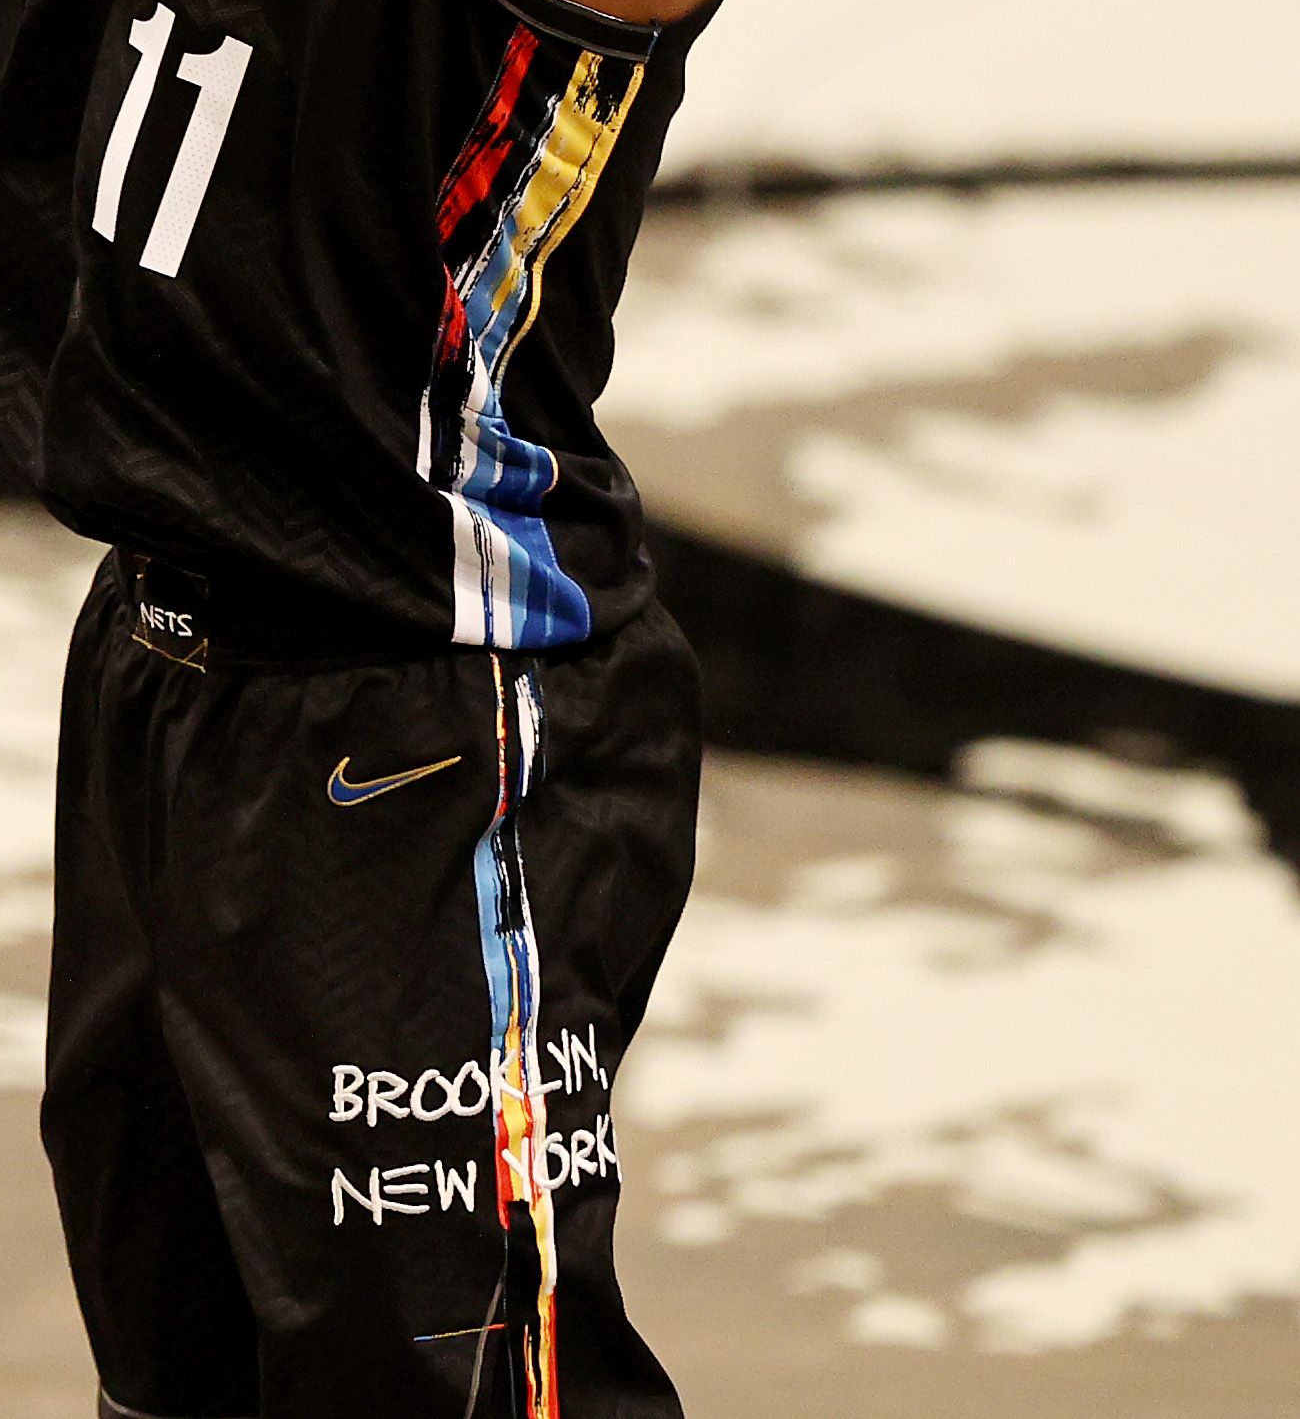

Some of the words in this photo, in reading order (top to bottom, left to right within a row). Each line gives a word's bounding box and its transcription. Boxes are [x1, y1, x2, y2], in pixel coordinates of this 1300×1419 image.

[92, 2, 254, 278] 11
[140, 601, 193, 637] NETS
[331, 1159, 477, 1226] NEW
